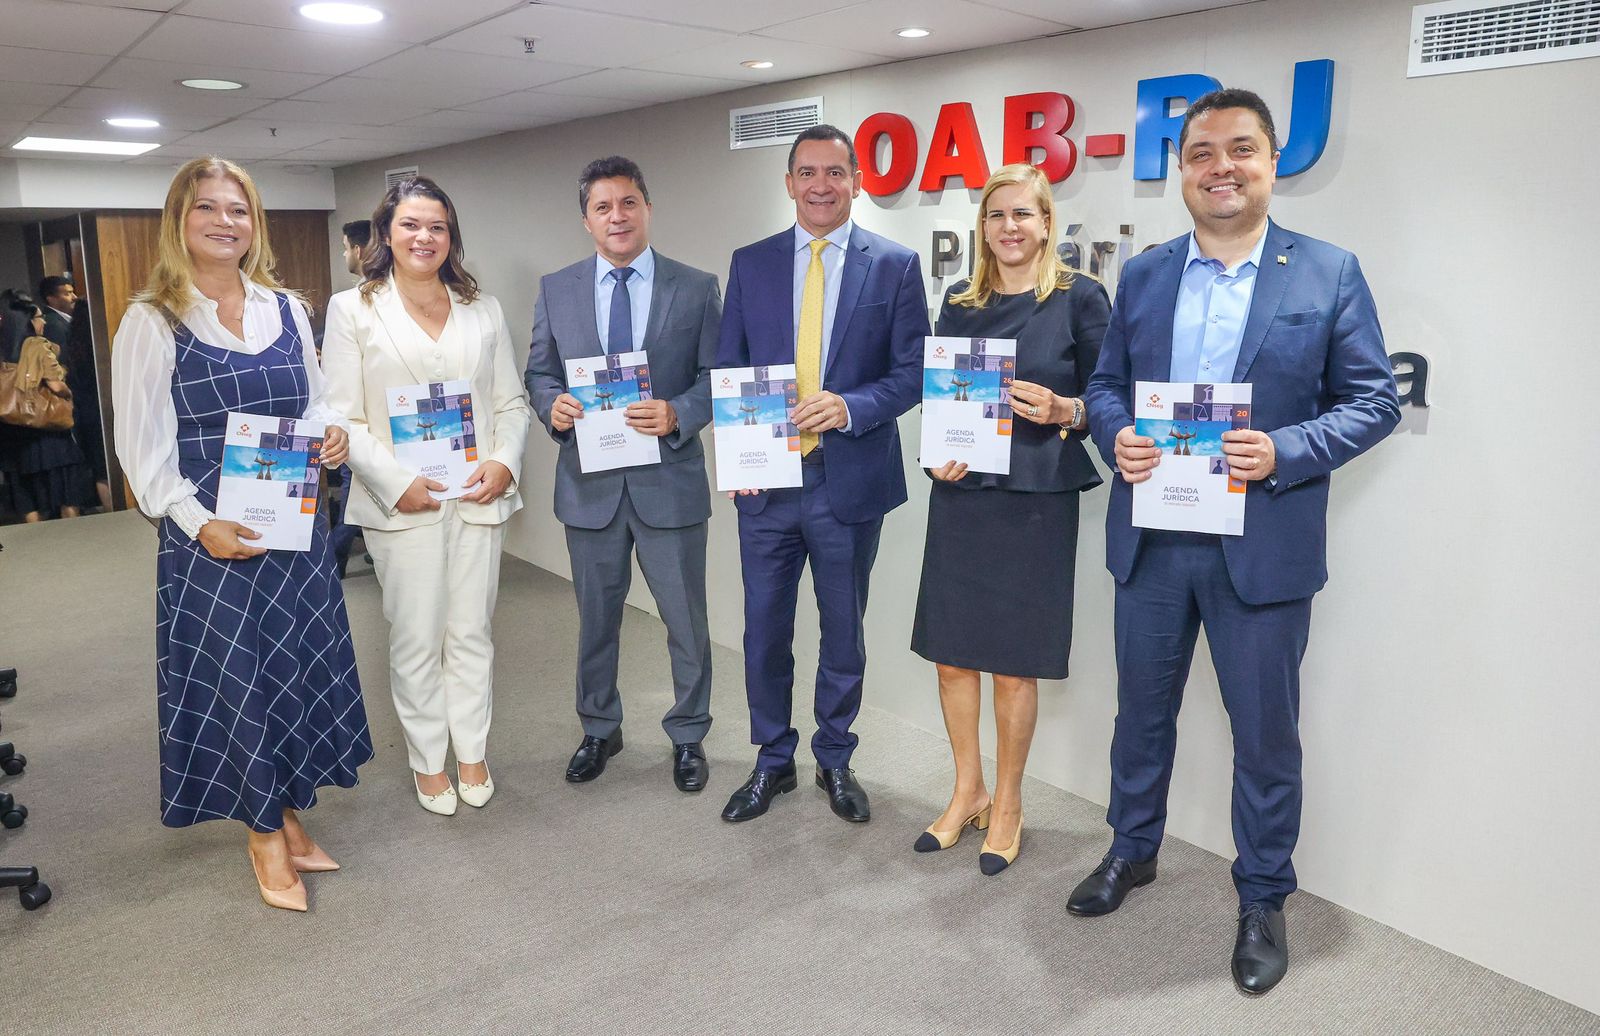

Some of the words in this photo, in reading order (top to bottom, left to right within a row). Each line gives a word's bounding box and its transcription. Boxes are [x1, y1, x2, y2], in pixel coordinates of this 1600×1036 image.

[853, 58, 1334, 196] OAB-RJ
[945, 428, 975, 437] AGENDA
[420, 464, 447, 473] AGENDA
[1163, 486, 1199, 495] AGENDA
[1162, 493, 1200, 503] JURÍDICA
[244, 507, 276, 515] AGENDA
[242, 513, 276, 523] JURÍDICA
